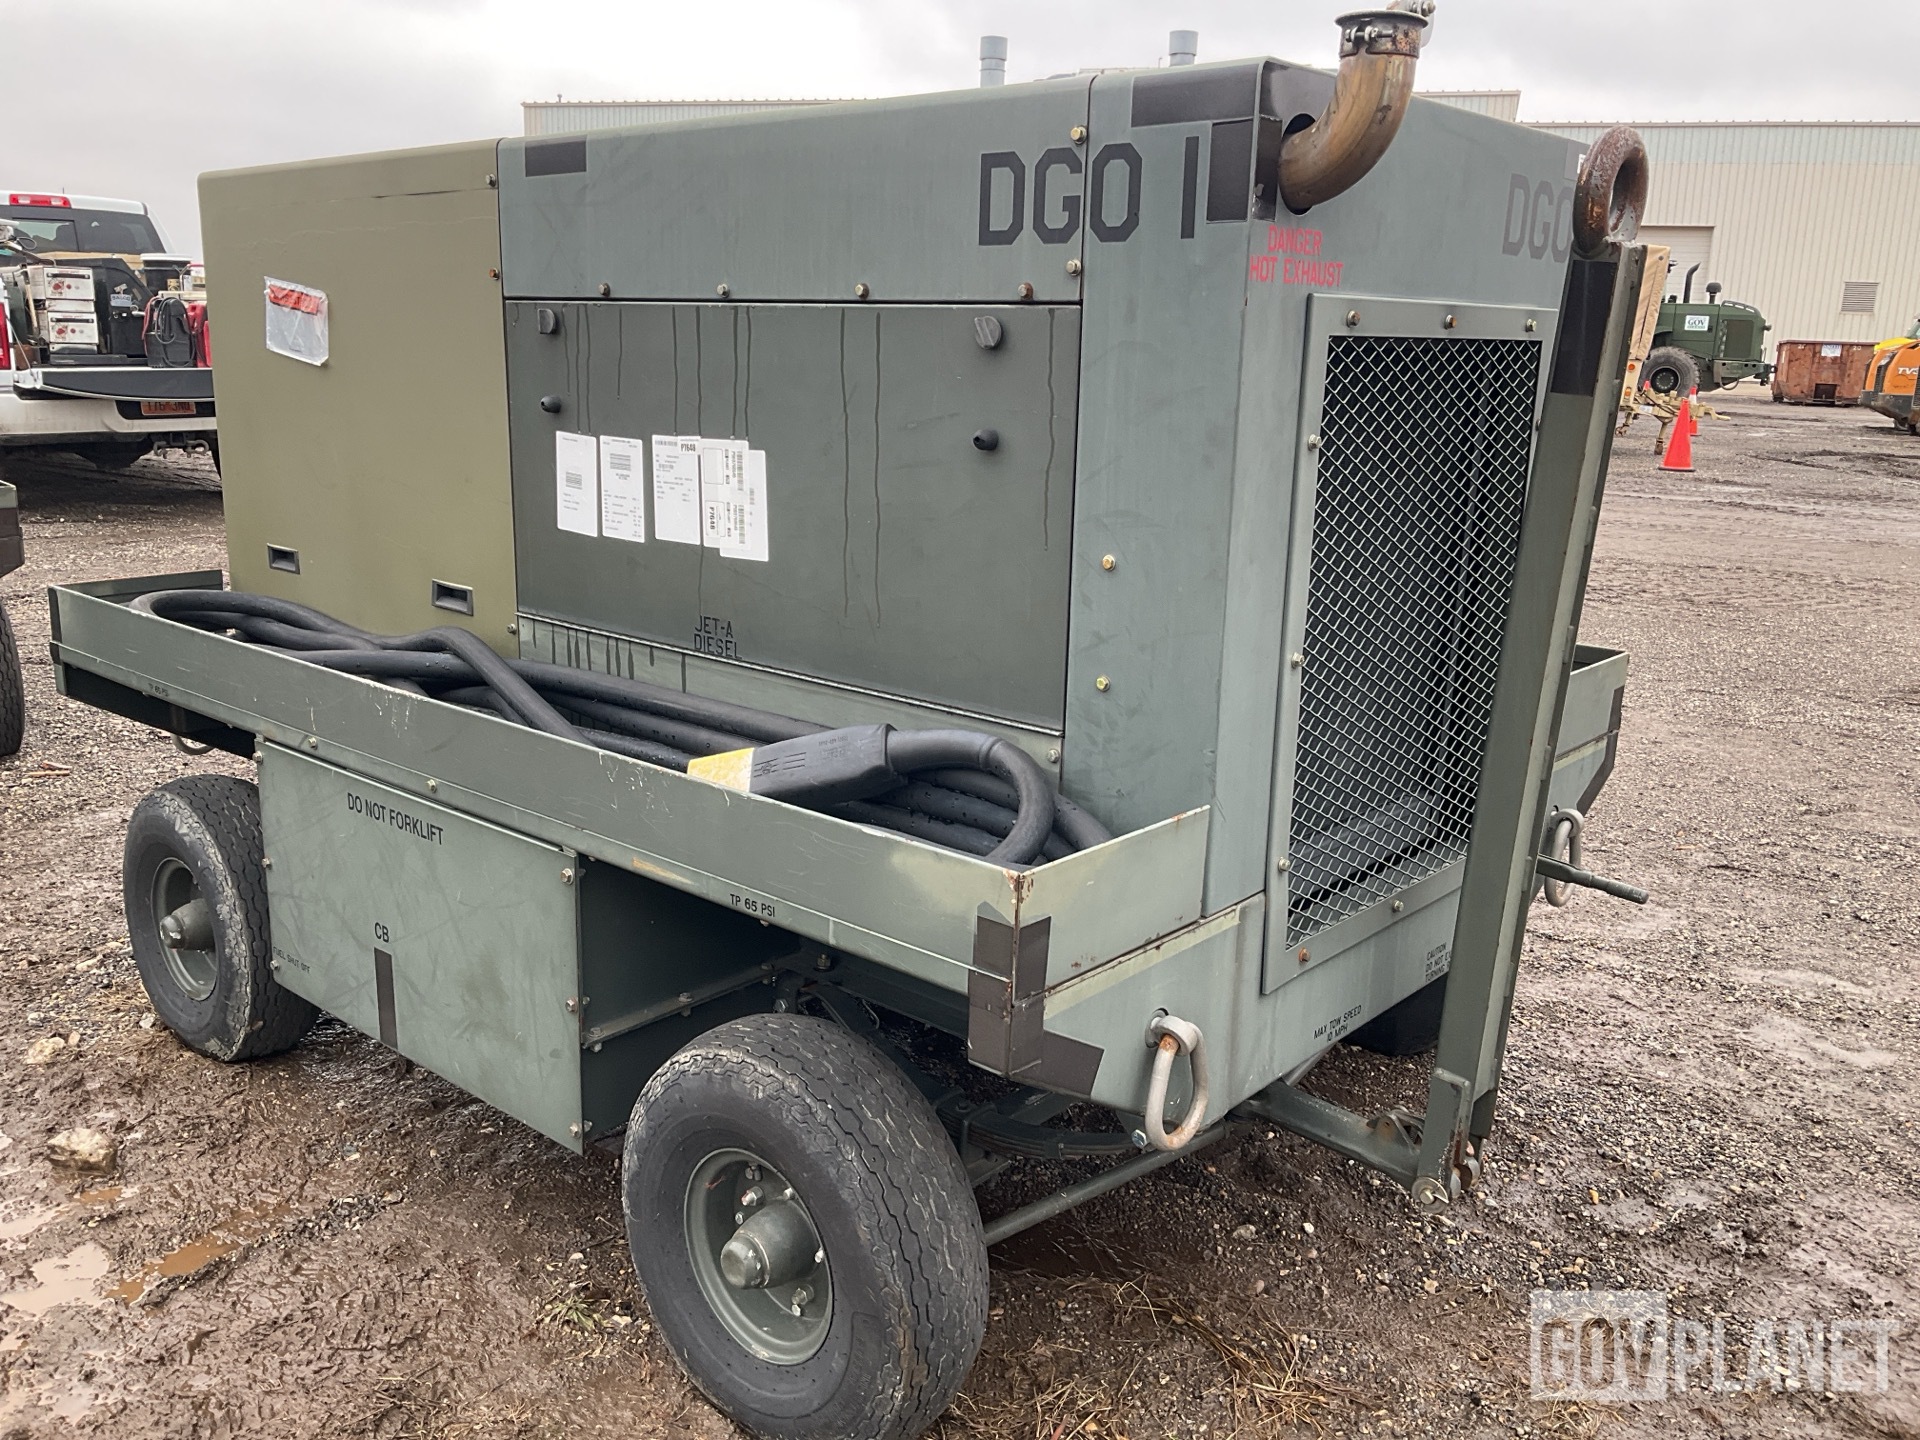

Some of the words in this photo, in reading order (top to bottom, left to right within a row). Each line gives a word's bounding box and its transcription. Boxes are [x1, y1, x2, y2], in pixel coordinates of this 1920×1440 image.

[1268, 224, 1323, 256] DANGER
[1249, 254, 1278, 283] HOT
[1283, 257, 1345, 288] EXHAUST
[694, 614, 734, 639] JET-A
[693, 633, 743, 660] DIESEL
[347, 792, 363, 814] DO
[365, 798, 387, 823] NOT
[389, 808, 444, 846] FORKLIFT
[729, 893, 741, 907] TP
[744, 897, 758, 912] 65
[761, 902, 776, 918] PSI
[374, 921, 390, 943] CB
[272, 945, 287, 961] FUEL
[1425, 961, 1433, 974] DO
[1433, 954, 1444, 969] NOT
[1426, 942, 1447, 961] CAUTION
[1313, 1024, 1328, 1041] MAX
[1328, 1016, 1342, 1032] TOW
[1342, 1004, 1362, 1023] SPEED
[1326, 1030, 1334, 1044] 10
[1334, 1023, 1349, 1038] MPH
